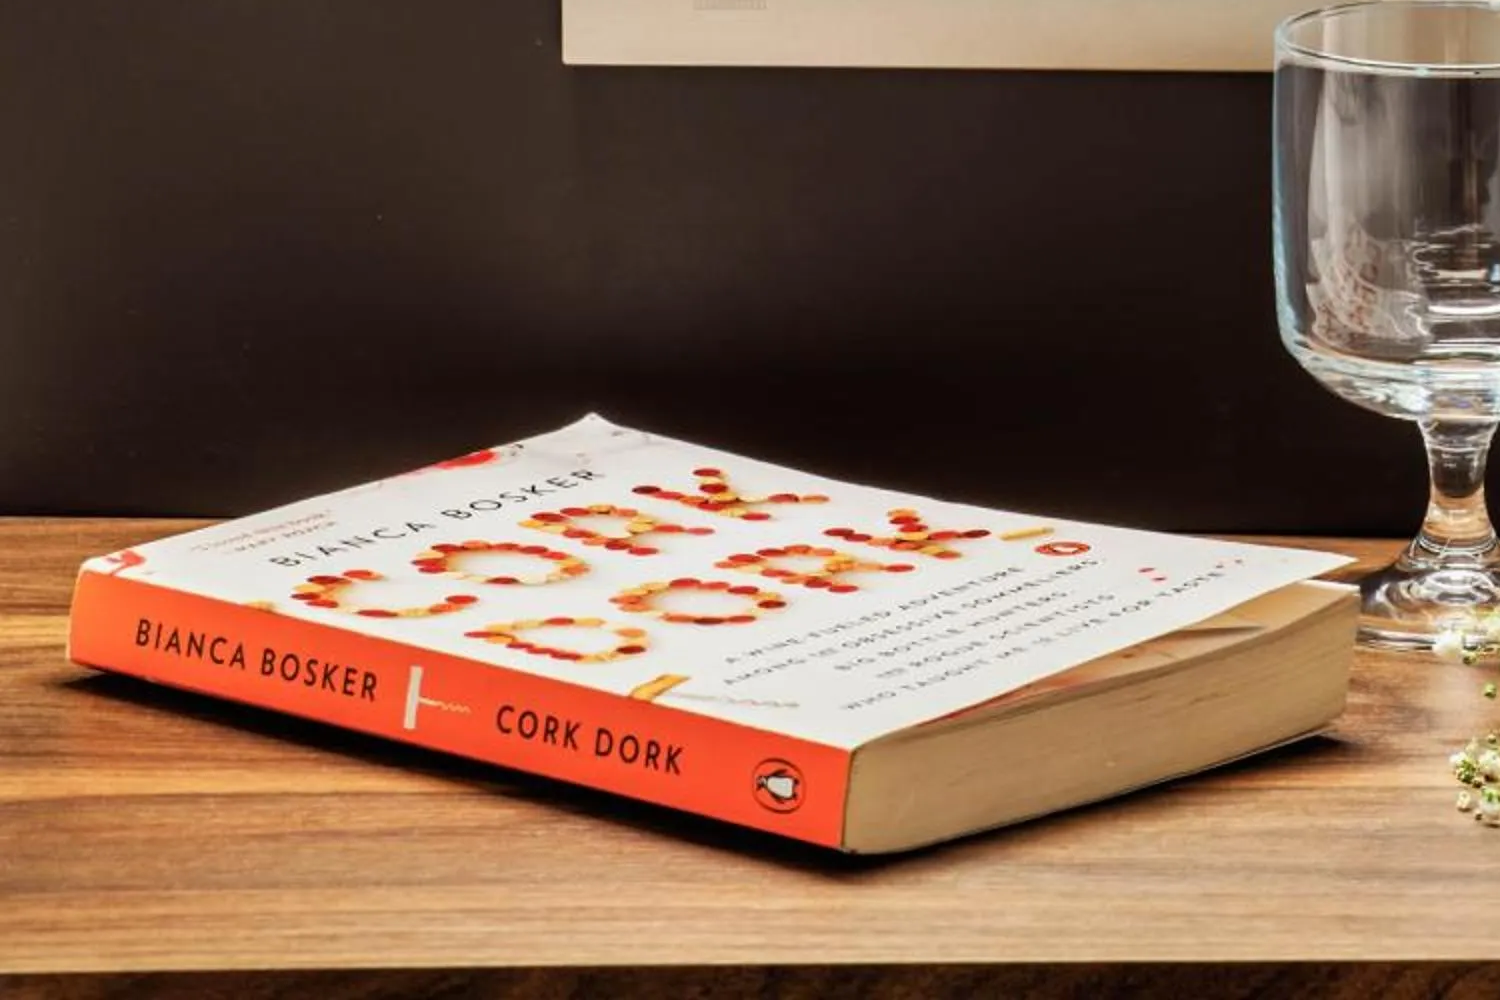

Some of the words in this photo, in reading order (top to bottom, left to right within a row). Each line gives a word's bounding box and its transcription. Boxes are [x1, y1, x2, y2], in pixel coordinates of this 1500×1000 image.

[269, 519, 437, 567] BIANCA
[441, 469, 606, 520] BOSKER
[290, 466, 830, 618] CORK
[463, 508, 992, 664] DORK
[898, 566, 1025, 611] ADVENTURE
[1108, 599, 1151, 617] FOR
[840, 609, 959, 648] OBSESSIVE
[989, 594, 1115, 640] SCIENTISTS
[877, 627, 963, 657] BOTTLE
[135, 618, 246, 672] BIANCA
[260, 646, 378, 703] BOSKER
[495, 704, 581, 751] CORK
[594, 726, 685, 776] DORK
